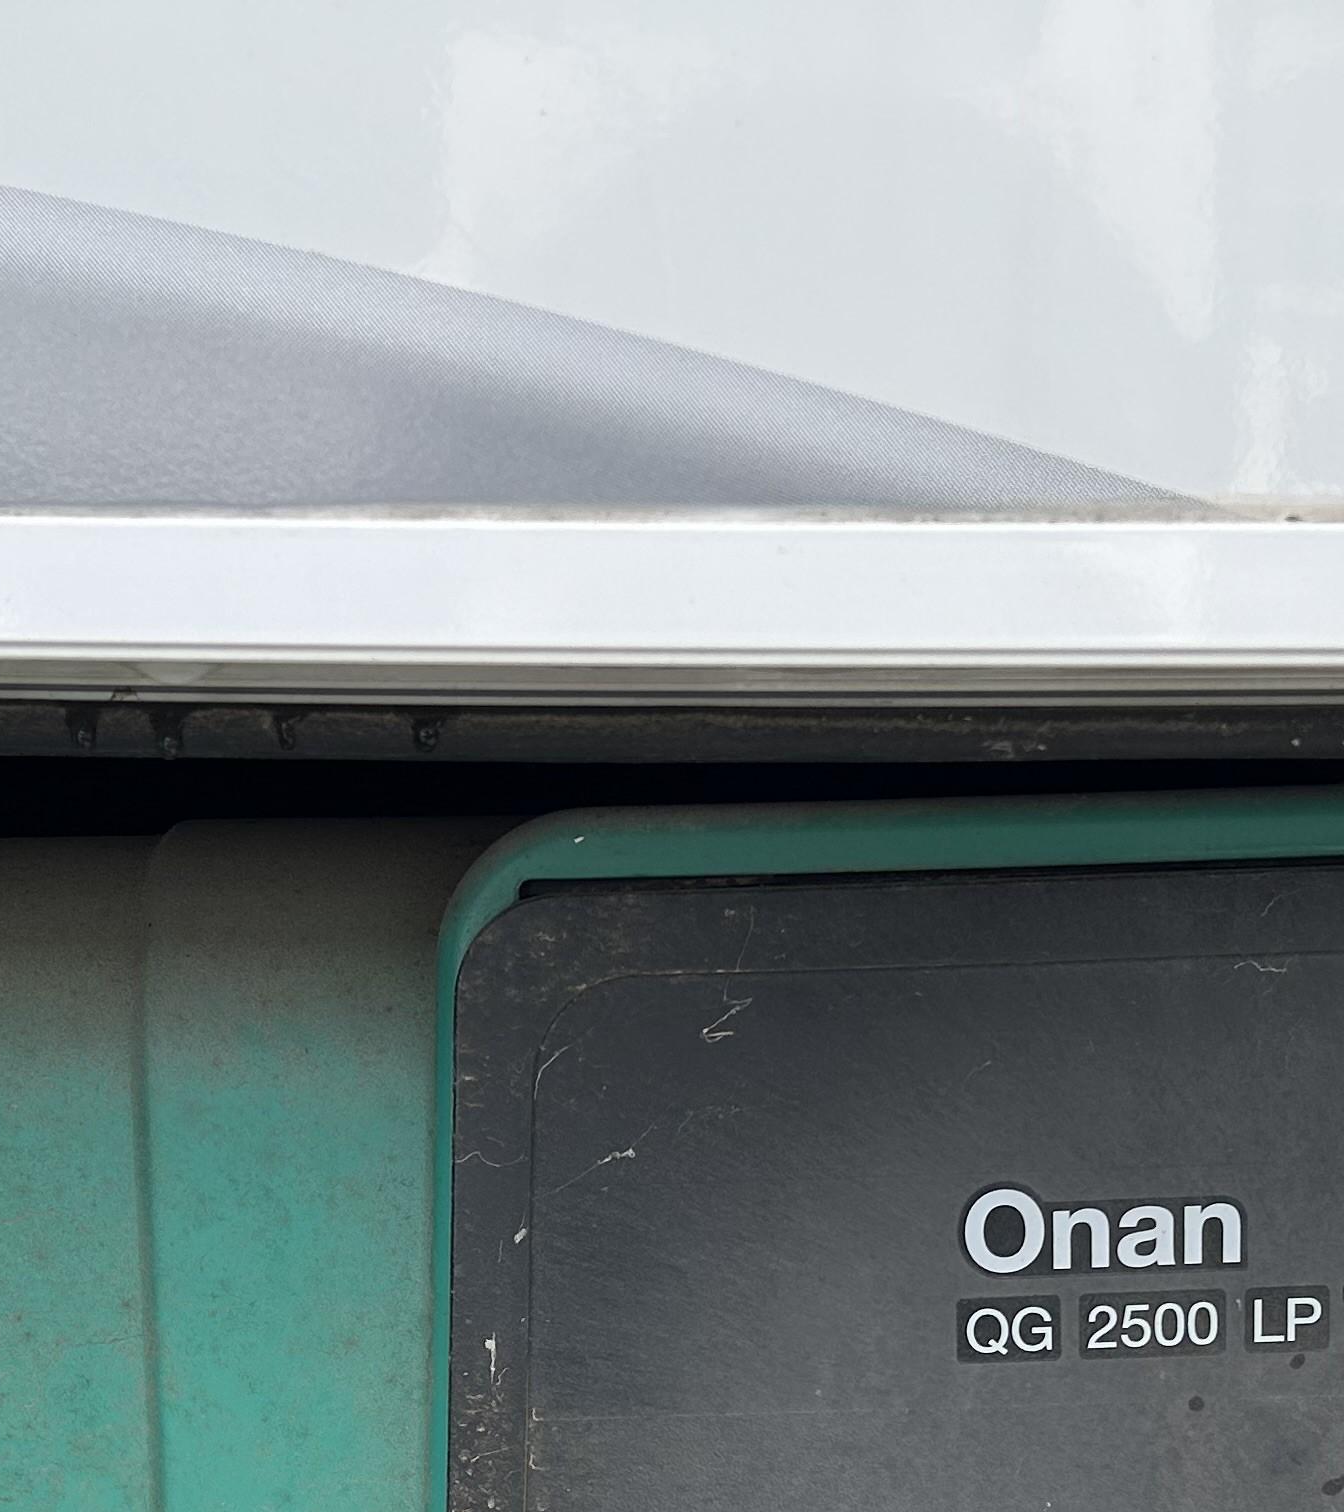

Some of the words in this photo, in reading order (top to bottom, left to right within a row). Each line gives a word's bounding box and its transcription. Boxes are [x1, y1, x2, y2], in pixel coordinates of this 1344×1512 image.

[964, 1188, 1241, 1273] Onan
[966, 1306, 1054, 1355] QG
[1087, 1301, 1219, 1349] 2500
[1253, 1296, 1323, 1343] LP
